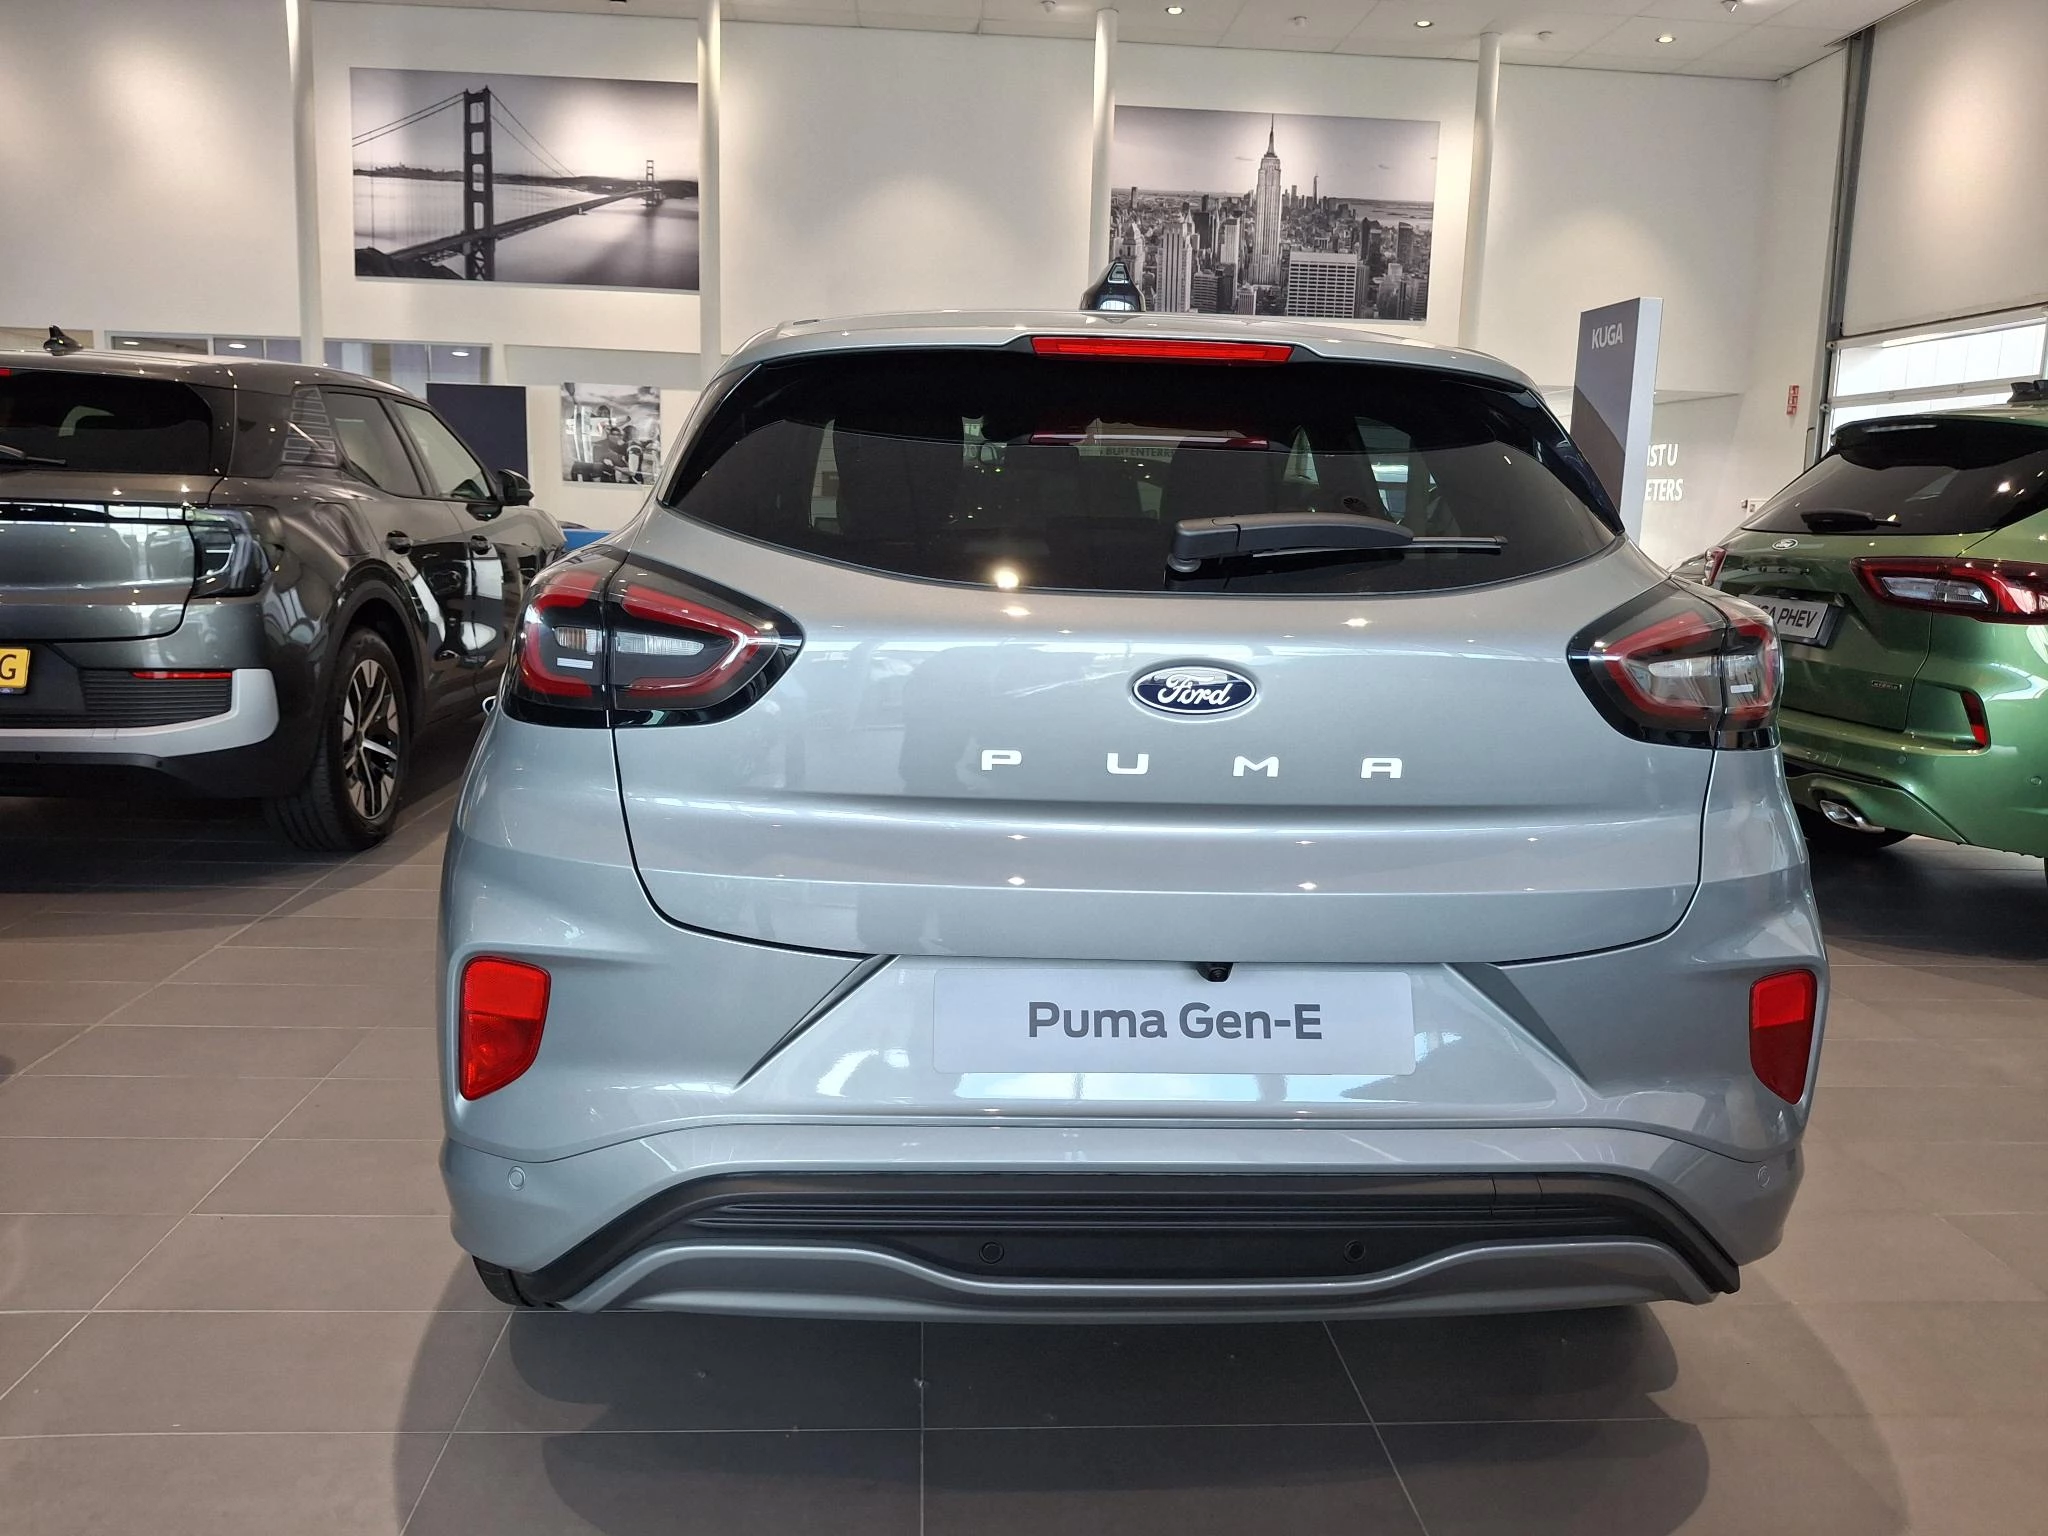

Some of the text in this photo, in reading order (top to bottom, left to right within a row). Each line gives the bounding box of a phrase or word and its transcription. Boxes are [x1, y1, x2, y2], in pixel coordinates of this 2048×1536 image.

[1591, 323, 1623, 349] KUGA
[1667, 444, 1679, 467] U
[1776, 607, 1818, 628] PHEV
[1157, 673, 1233, 705] Ford
[981, 749, 1402, 779] PUMA
[1028, 1001, 1322, 1040] Puma Gen-E
